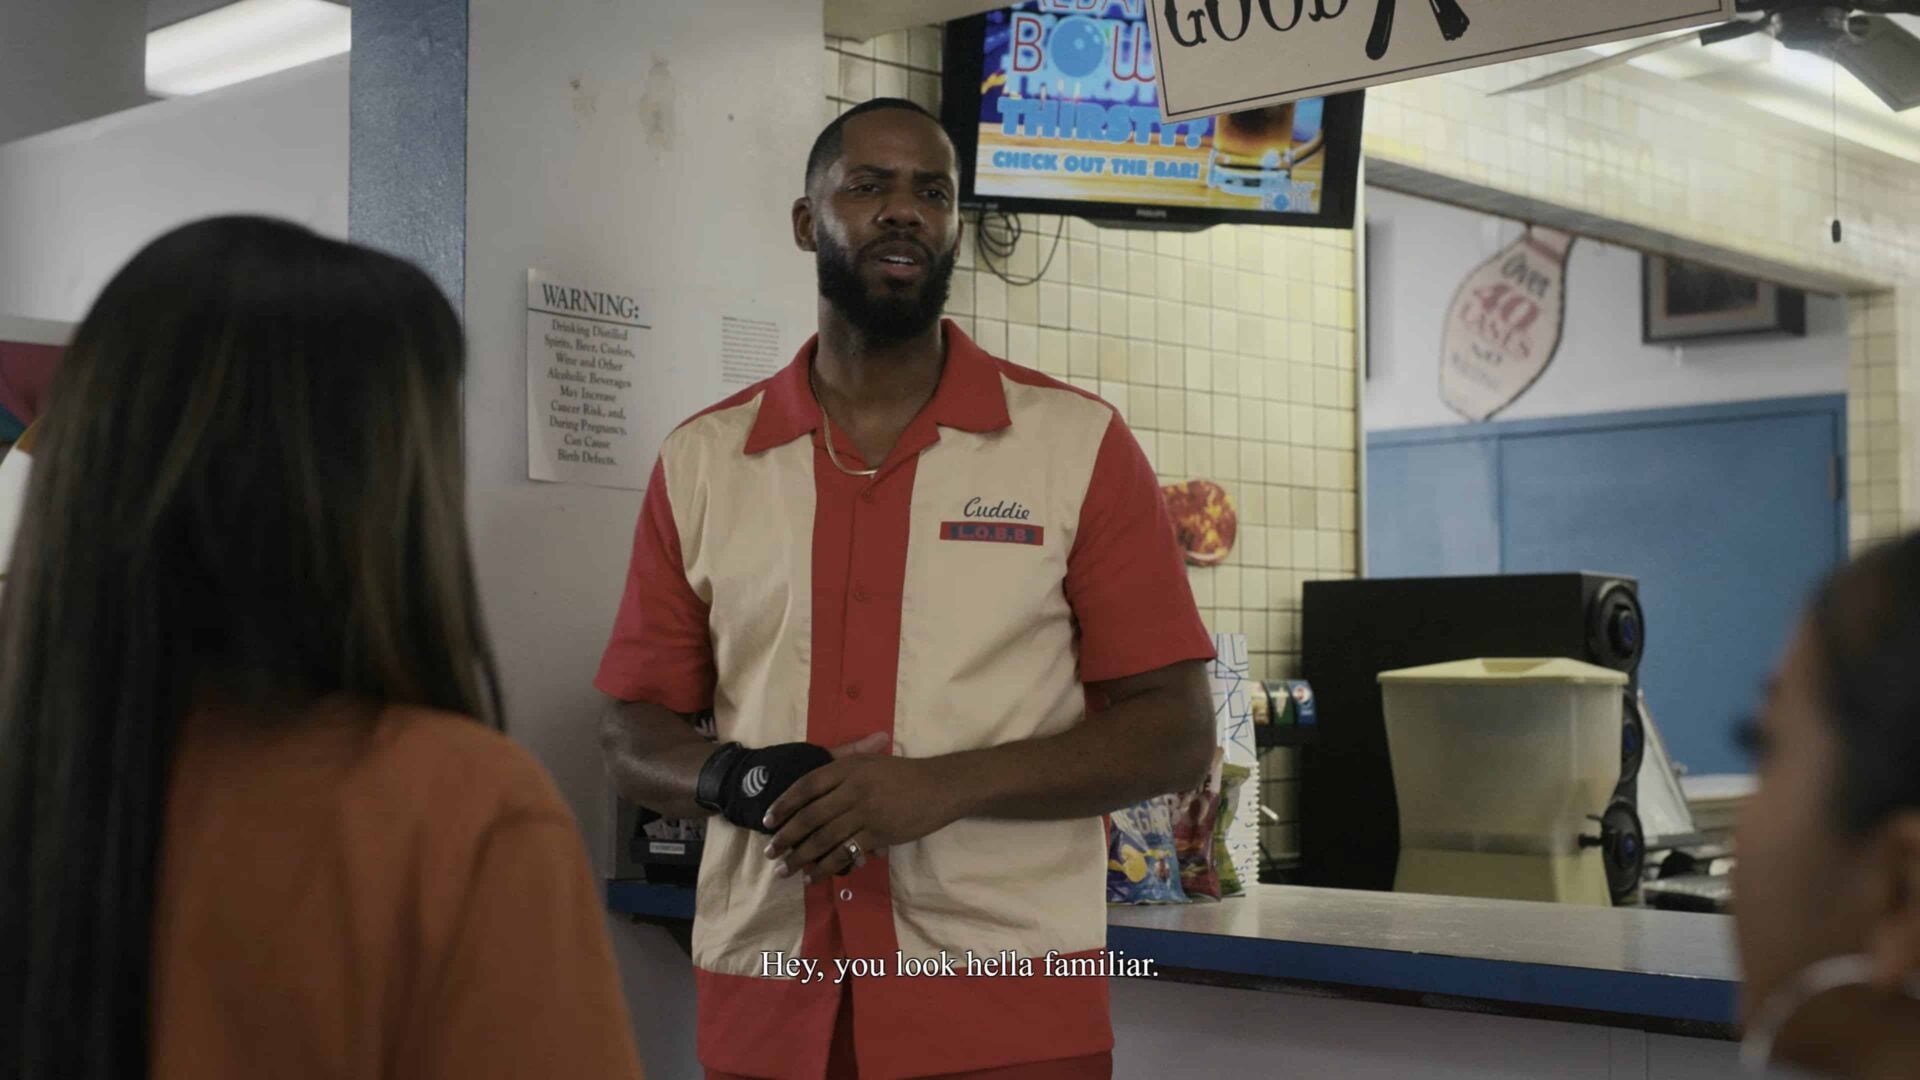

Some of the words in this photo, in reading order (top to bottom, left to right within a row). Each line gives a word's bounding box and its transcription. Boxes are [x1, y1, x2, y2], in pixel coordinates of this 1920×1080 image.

[992, 151, 1058, 171] CHECK
[1064, 154, 1106, 174] OUT
[1111, 158, 1148, 176] THE
[1153, 161, 1200, 180] BAR!
[542, 283, 639, 319] WARNING:
[1473, 283, 1540, 330] 40
[552, 319, 590, 338] Drinking
[592, 325, 628, 341] Distilled
[544, 334, 573, 349] Spirits,
[576, 339, 598, 353] Beer,
[600, 343, 635, 358] Coolers,
[556, 352, 577, 365] Wine
[580, 356, 596, 368] and
[598, 358, 623, 371] Other
[547, 368, 586, 382] Alcoholic
[589, 372, 632, 389] Beverages
[560, 385, 578, 399] May
[581, 387, 616, 402] Increase
[551, 399, 580, 413] Cancer
[583, 403, 606, 418] Risk,
[549, 415, 579, 432] During
[581, 419, 627, 435] Pregnancy,
[564, 433, 582, 446] Can
[584, 435, 610, 448] Cause
[558, 448, 580, 462] Birth
[582, 450, 617, 465] Defects.
[963, 496, 1030, 520] Cuddie
